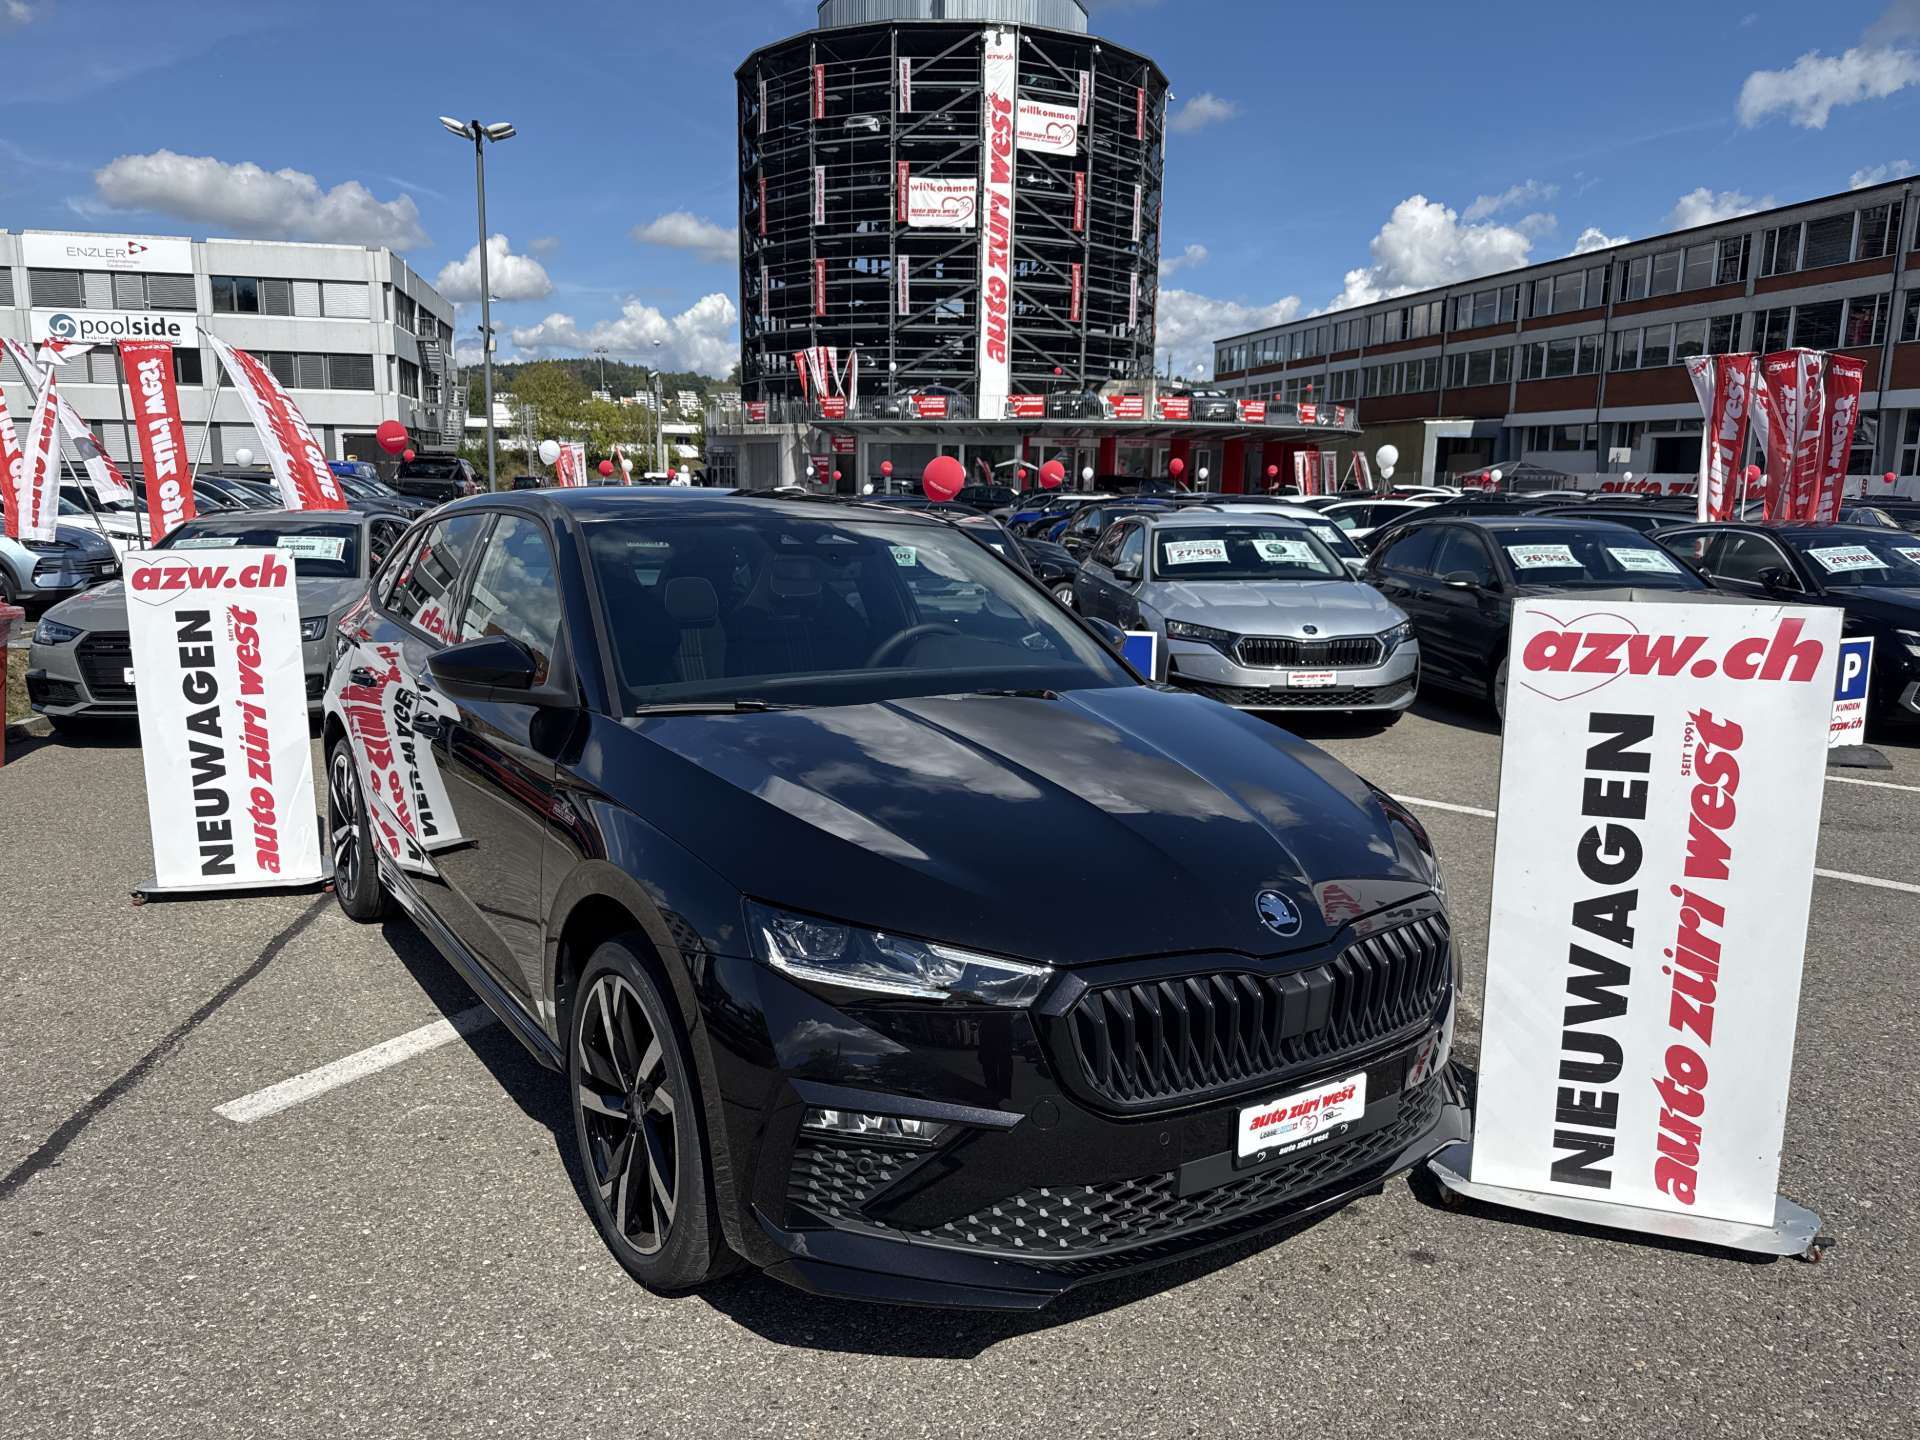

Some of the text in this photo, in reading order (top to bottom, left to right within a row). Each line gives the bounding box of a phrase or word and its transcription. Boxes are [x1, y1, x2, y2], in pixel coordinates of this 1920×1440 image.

[1019, 105, 1076, 121] willkommen
[910, 184, 975, 193] willkommen
[66, 246, 126, 259] ENZLER
[984, 91, 1013, 364] auto züri west
[80, 315, 181, 340] poolside
[1718, 366, 1746, 441] west
[305, 445, 339, 502] auto
[131, 553, 288, 591] azw.ch
[1521, 617, 1825, 682] azw.ch
[1841, 652, 1862, 693] P
[1835, 702, 1861, 712] KUNDEN
[175, 609, 236, 877] NEUWAGEN
[227, 604, 281, 875] auto züri west
[1681, 721, 1695, 776] SEIT 1991
[1550, 711, 1655, 1189] NEUWAGEN
[1651, 708, 1744, 1206] auto züri west
[1249, 1108, 1287, 1131] auto
[1287, 1094, 1322, 1119] züri
[1322, 1084, 1356, 1108] west
[1278, 1132, 1330, 1155] auto züri west
